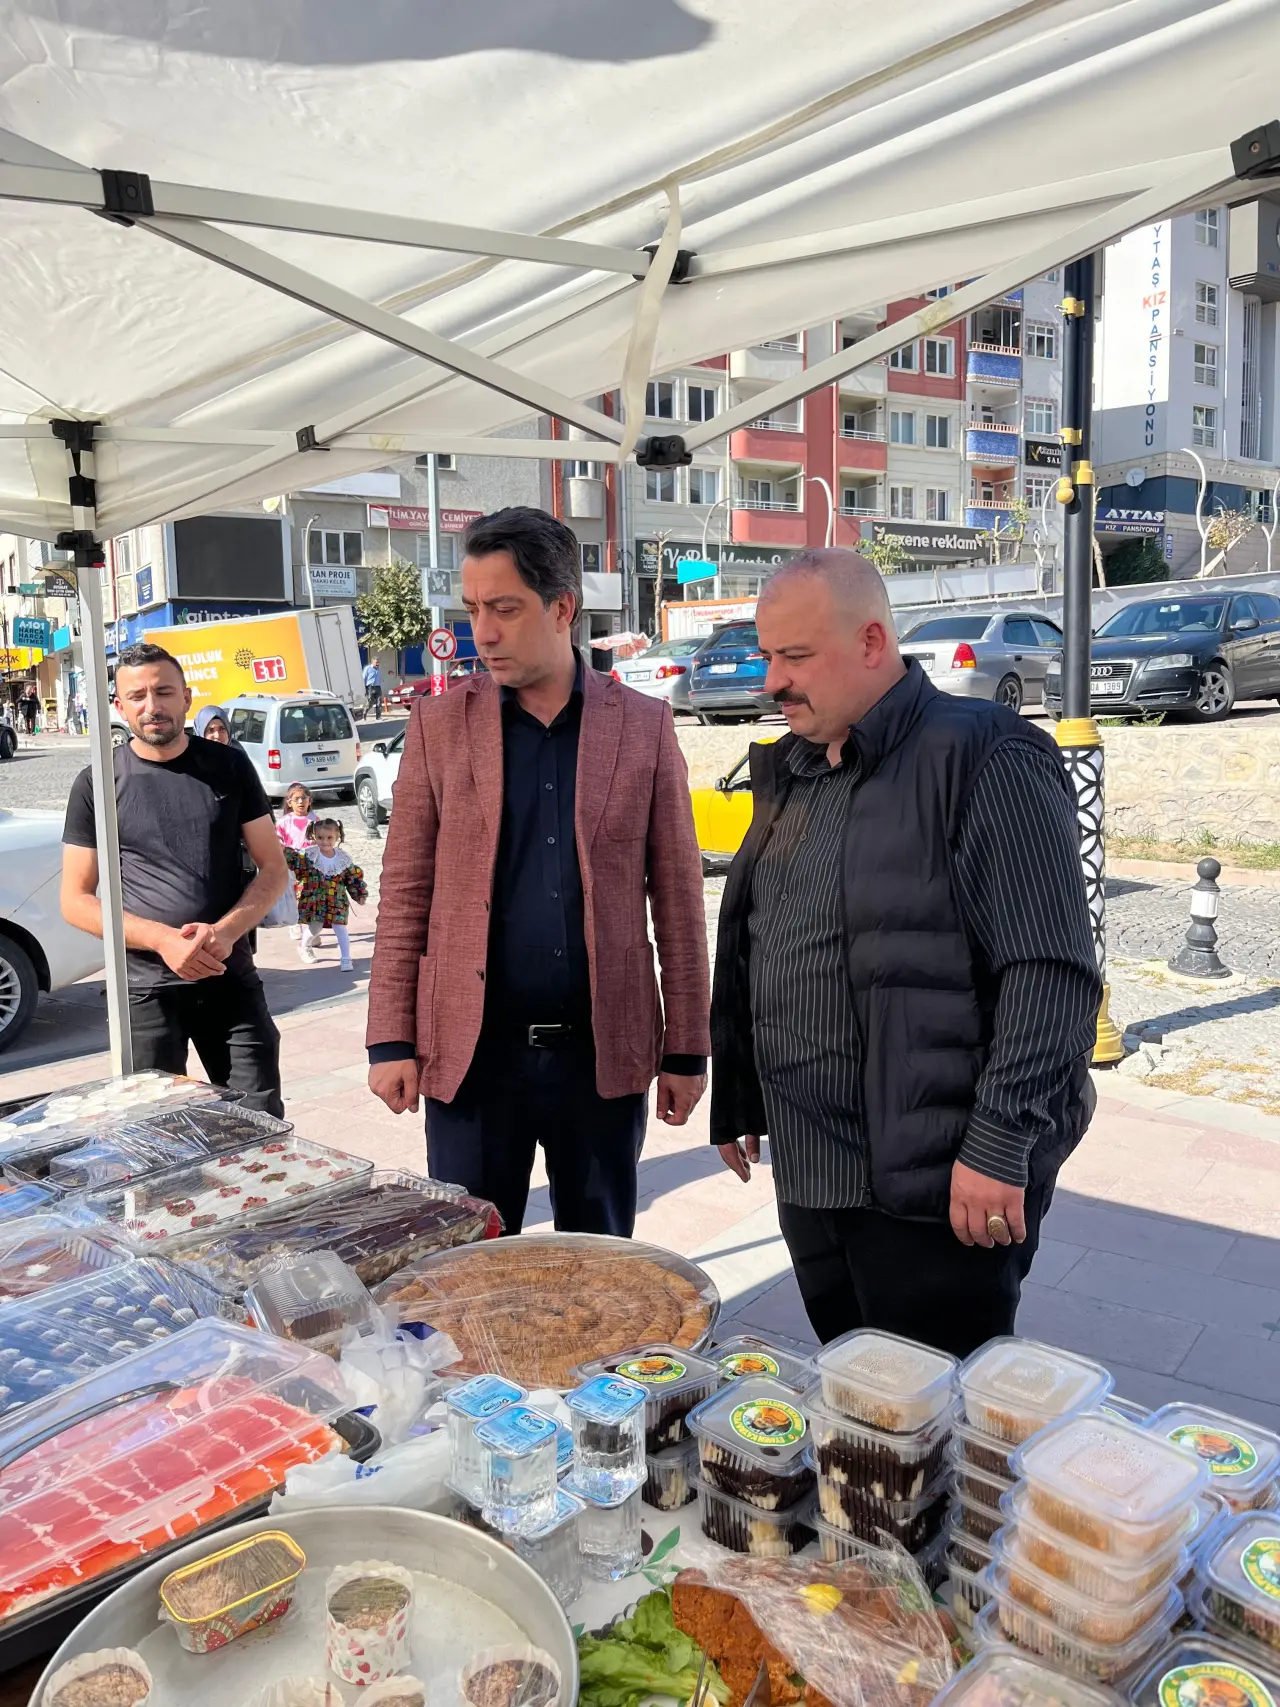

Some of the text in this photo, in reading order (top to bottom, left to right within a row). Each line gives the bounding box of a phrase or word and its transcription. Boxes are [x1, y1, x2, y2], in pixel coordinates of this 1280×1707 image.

[1143, 291, 1167, 309] KIZ
[1105, 508, 1165, 523] AYTAŞ
[931, 534, 977, 550] reklam
[328, 570, 351, 579] PROJE
